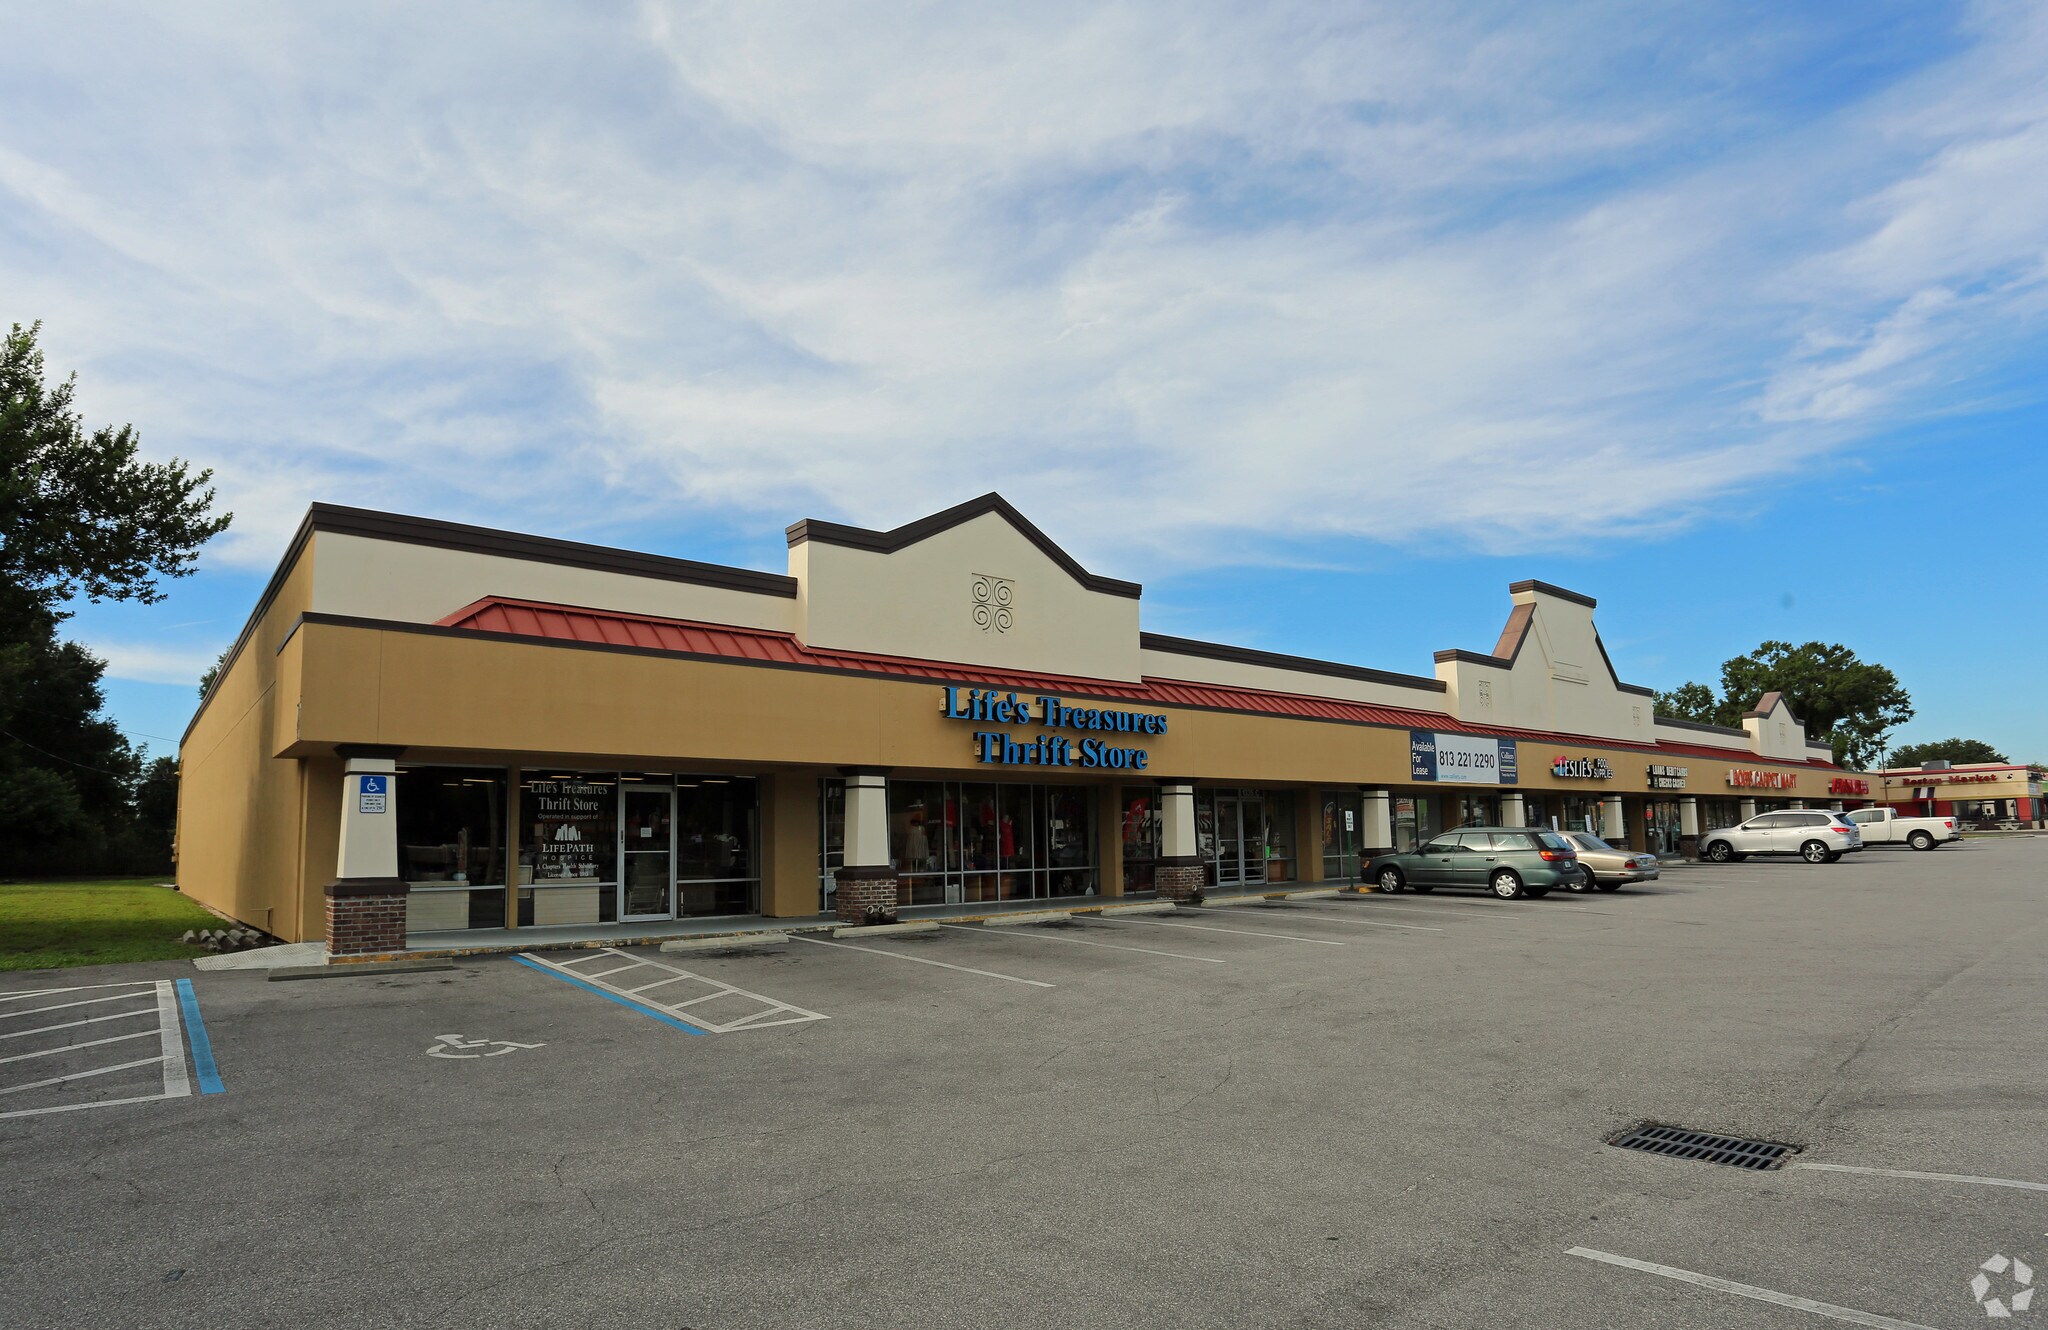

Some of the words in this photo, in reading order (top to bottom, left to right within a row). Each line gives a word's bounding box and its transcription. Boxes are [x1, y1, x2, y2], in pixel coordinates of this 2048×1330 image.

[944, 687, 1030, 724] Life's
[1037, 696, 1168, 735] Treasures
[974, 731, 1073, 767] Thrift
[1079, 738, 1149, 770] Store
[1411, 741, 1435, 753] Available
[1412, 753, 1422, 763] For
[1439, 750, 1455, 767] 813
[1457, 751, 1472, 768] 221
[1474, 753, 1495, 769] 2290
[1412, 766, 1429, 776] Lease
[1560, 757, 1592, 778] LESLIE'S
[1593, 768, 1613, 779] SUPPLIES
[1903, 777, 1943, 786] Boston
[1948, 773, 1998, 784] Market
[531, 781, 558, 794] Life's
[560, 781, 608, 795] Treasures
[539, 796, 571, 810] Thrift
[573, 798, 599, 811] Store
